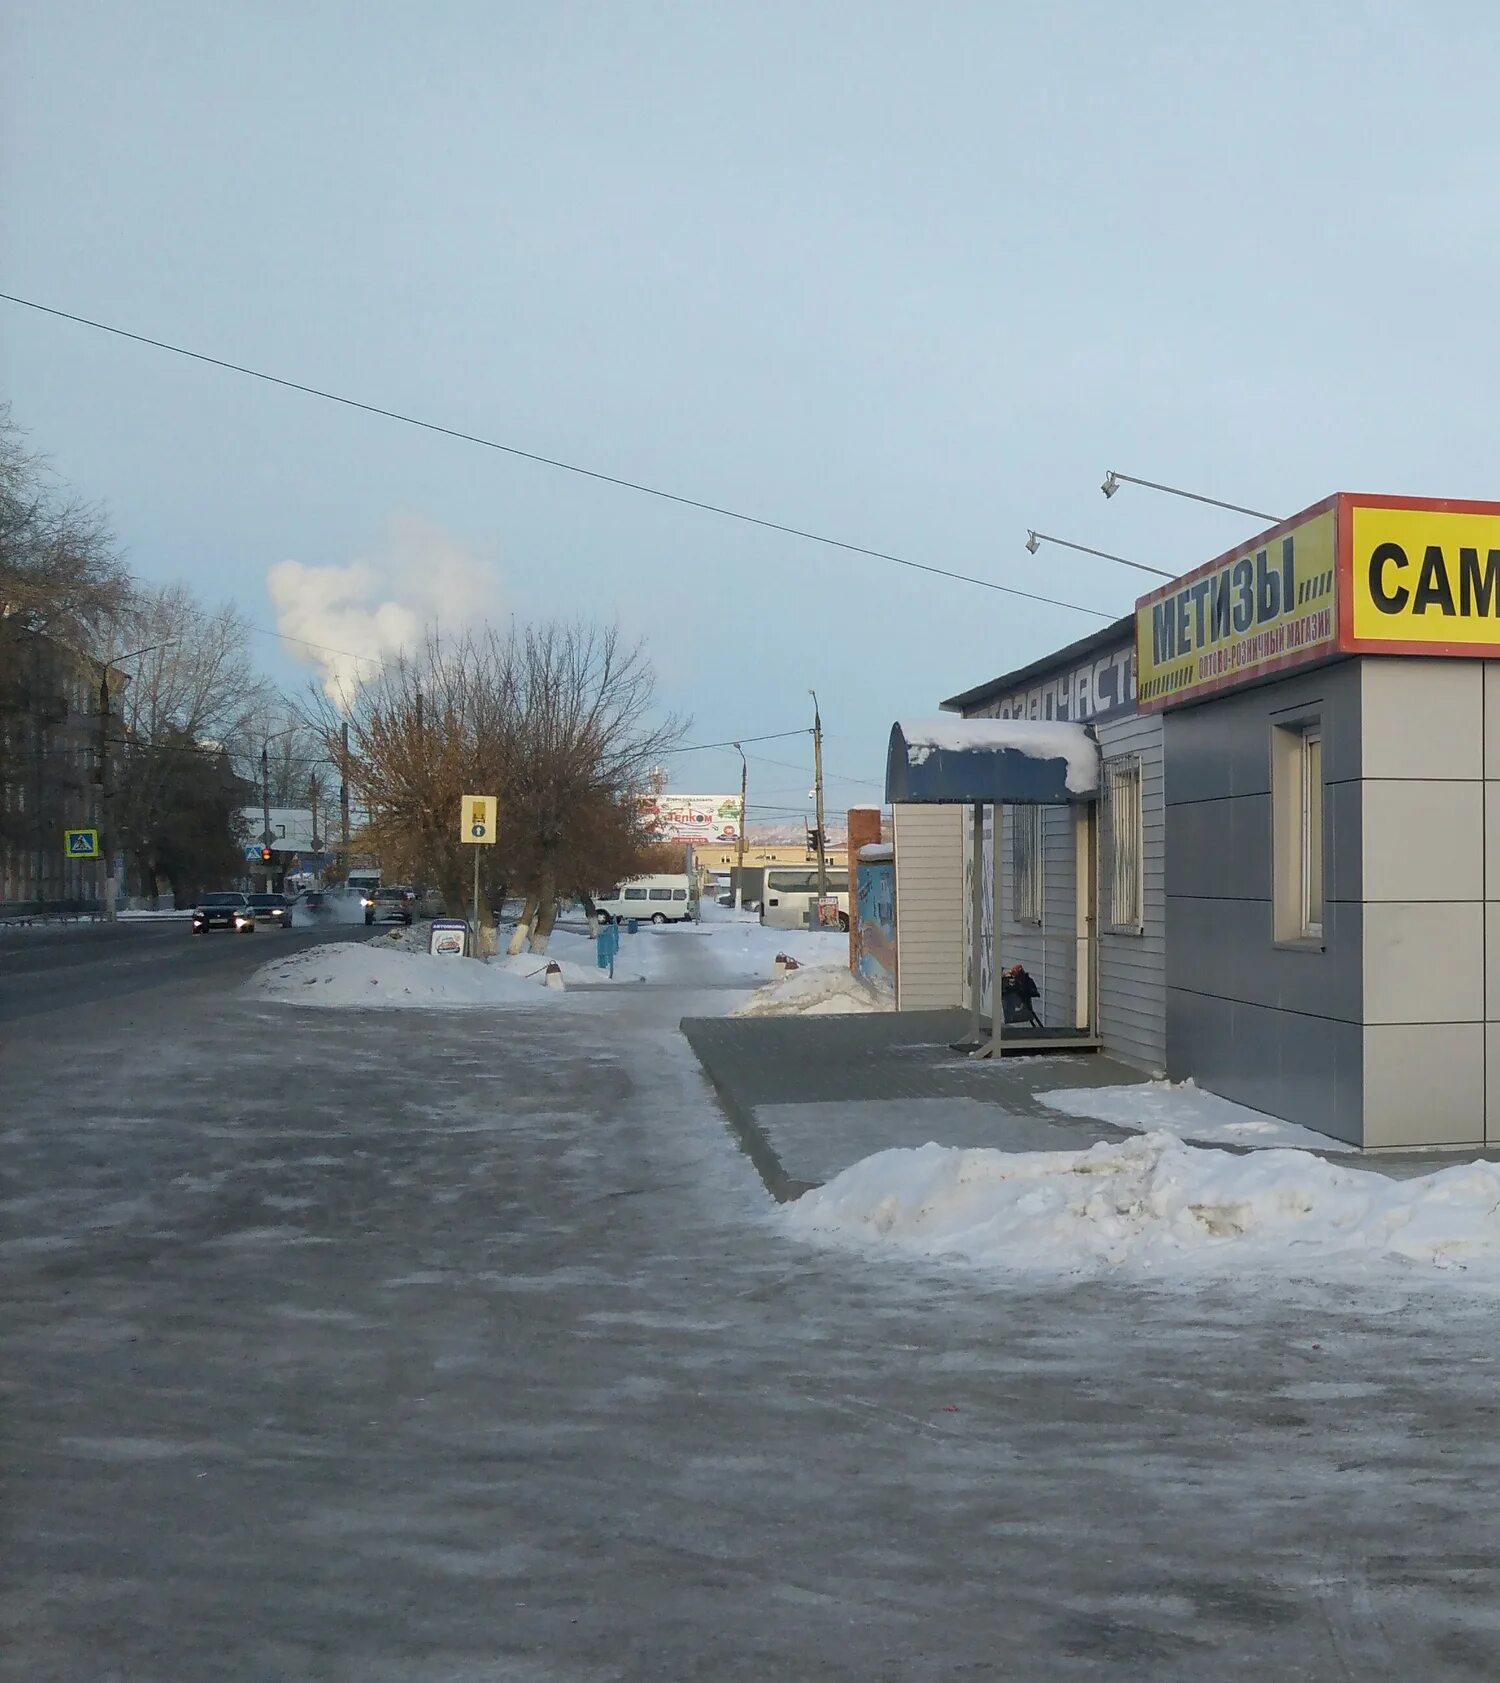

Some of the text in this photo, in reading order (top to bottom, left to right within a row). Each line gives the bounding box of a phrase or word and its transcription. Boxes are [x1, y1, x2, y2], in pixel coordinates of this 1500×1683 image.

[1152, 535, 1295, 668] МЕТИЗЫ
[1199, 607, 1331, 680] ОПТОВО-РОЗНИЧНЫЙ МАГАЗИН
[968, 645, 1138, 721] ОЗАПЧАСТ
